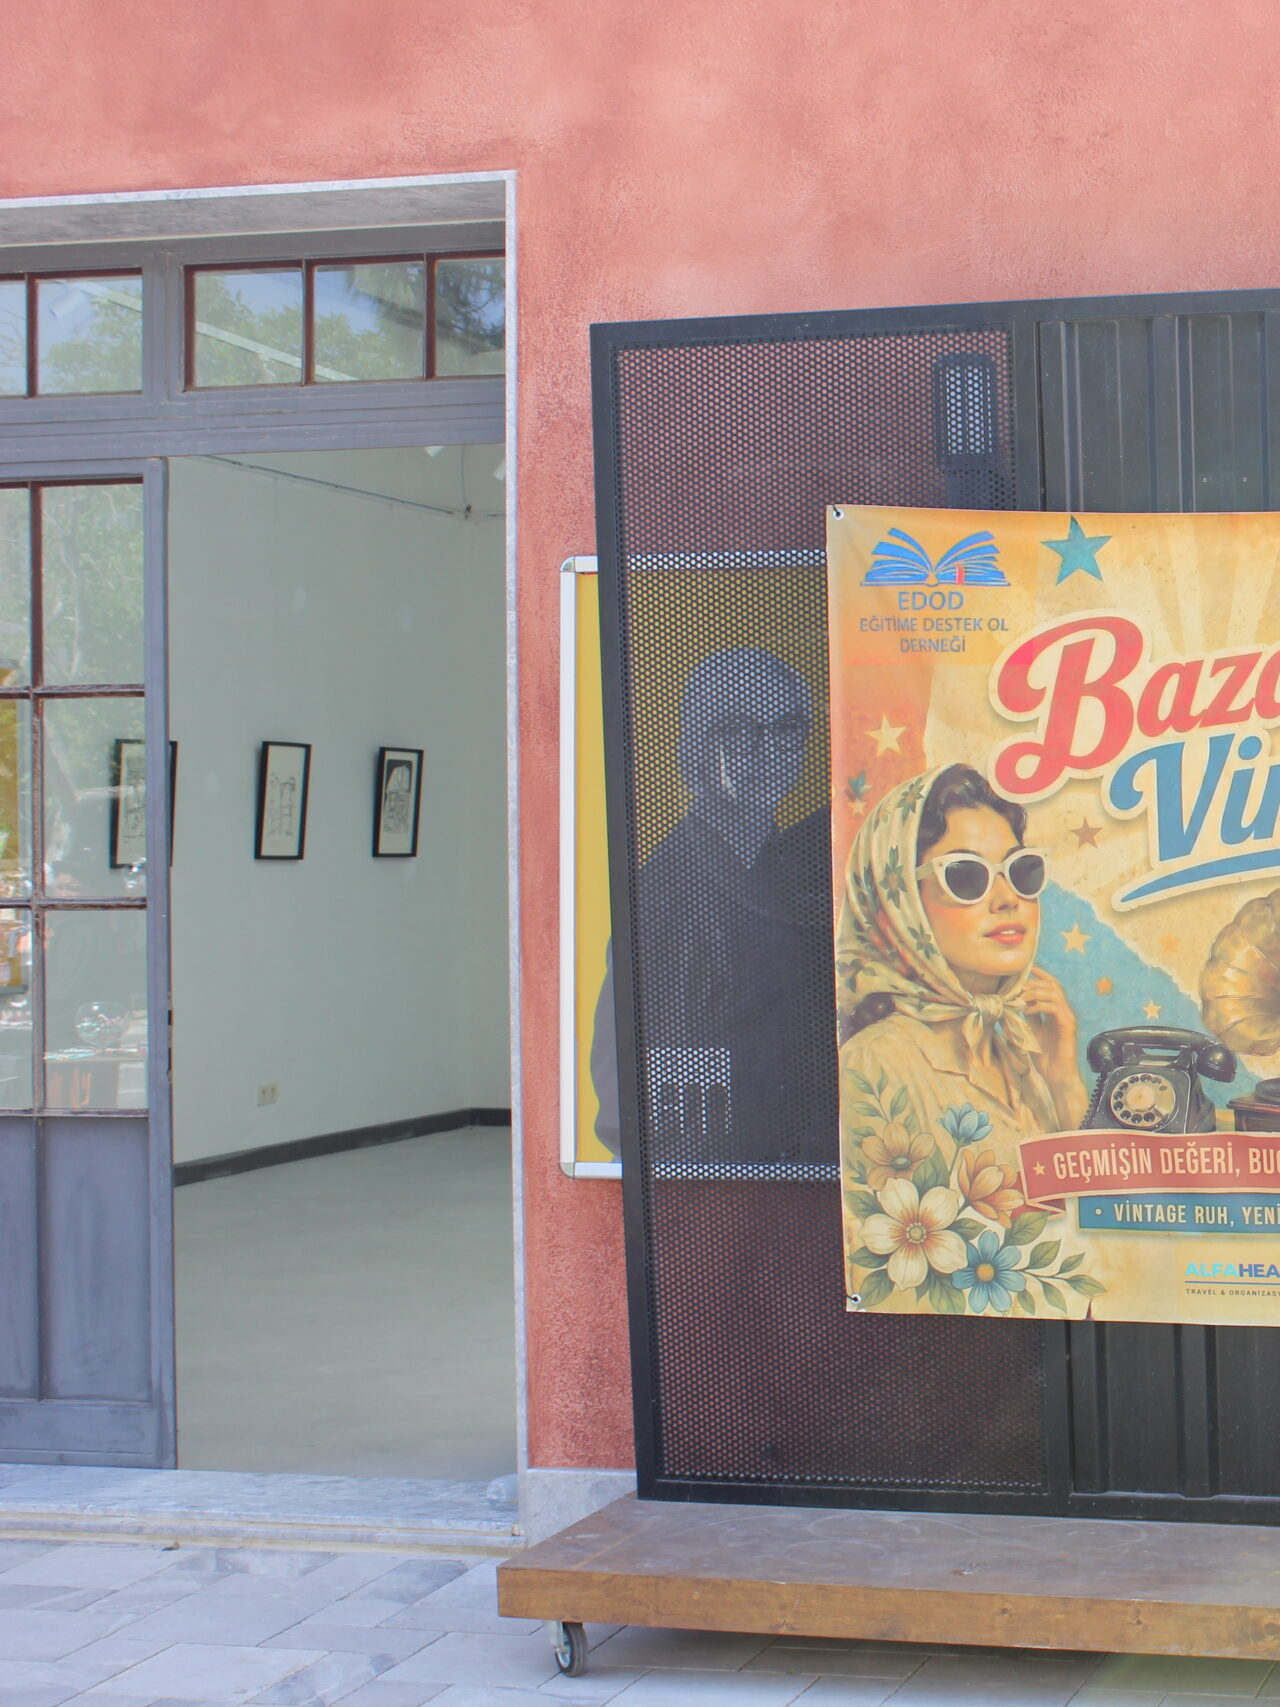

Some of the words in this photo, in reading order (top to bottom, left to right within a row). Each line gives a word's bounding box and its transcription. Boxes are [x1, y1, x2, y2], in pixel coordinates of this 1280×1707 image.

[897, 591, 964, 610] EDOD
[859, 615, 919, 632] EĞİTİME
[922, 617, 983, 632] DESTEK
[987, 617, 1009, 632] OL
[900, 635, 966, 653] DERNEĞİ
[1053, 1142, 1152, 1183] GEÇMİŞİN
[1160, 1141, 1241, 1178] DEĞERİ,
[1113, 1200, 1187, 1223] VİNTAGE
[1195, 1206, 1235, 1227] RUH,
[1186, 1288, 1217, 1296] TRAVEL
